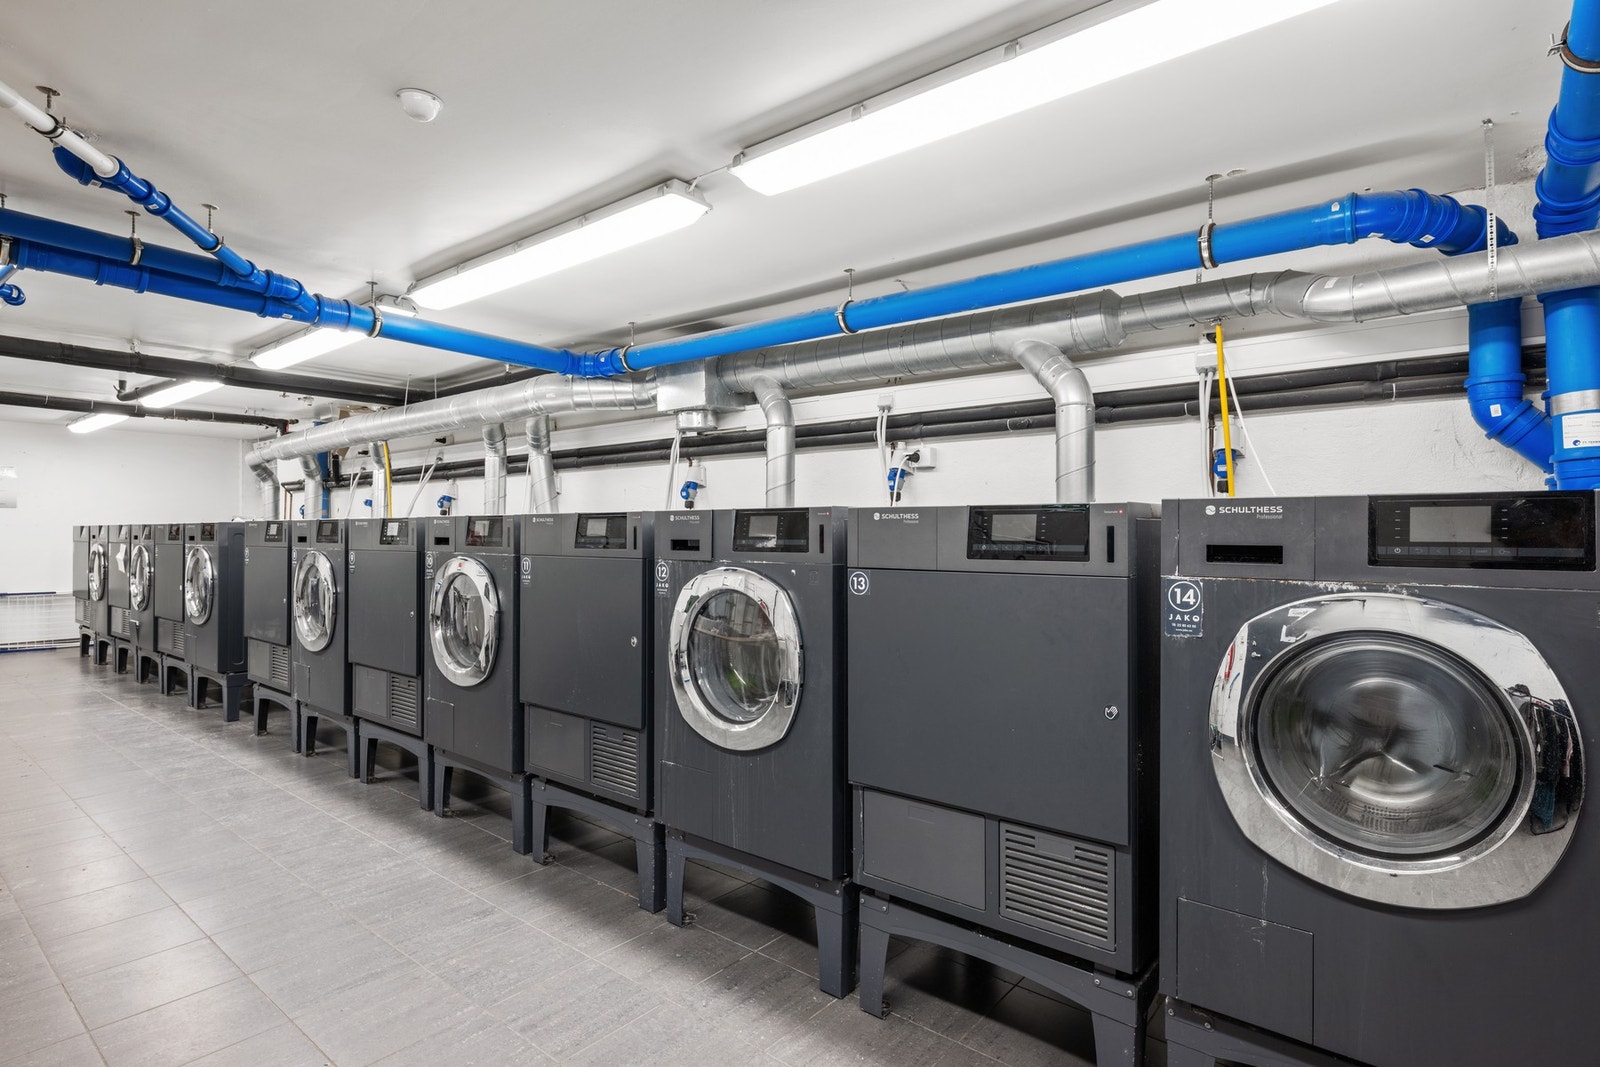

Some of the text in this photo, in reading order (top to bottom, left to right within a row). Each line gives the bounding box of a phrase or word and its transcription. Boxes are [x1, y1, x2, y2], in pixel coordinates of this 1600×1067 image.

[1219, 506, 1283, 514] SCHULTHESS
[657, 566, 667, 578] 12
[852, 577, 866, 590] 13
[1174, 588, 1196, 605] 14
[1168, 613, 1200, 622] JAKO
